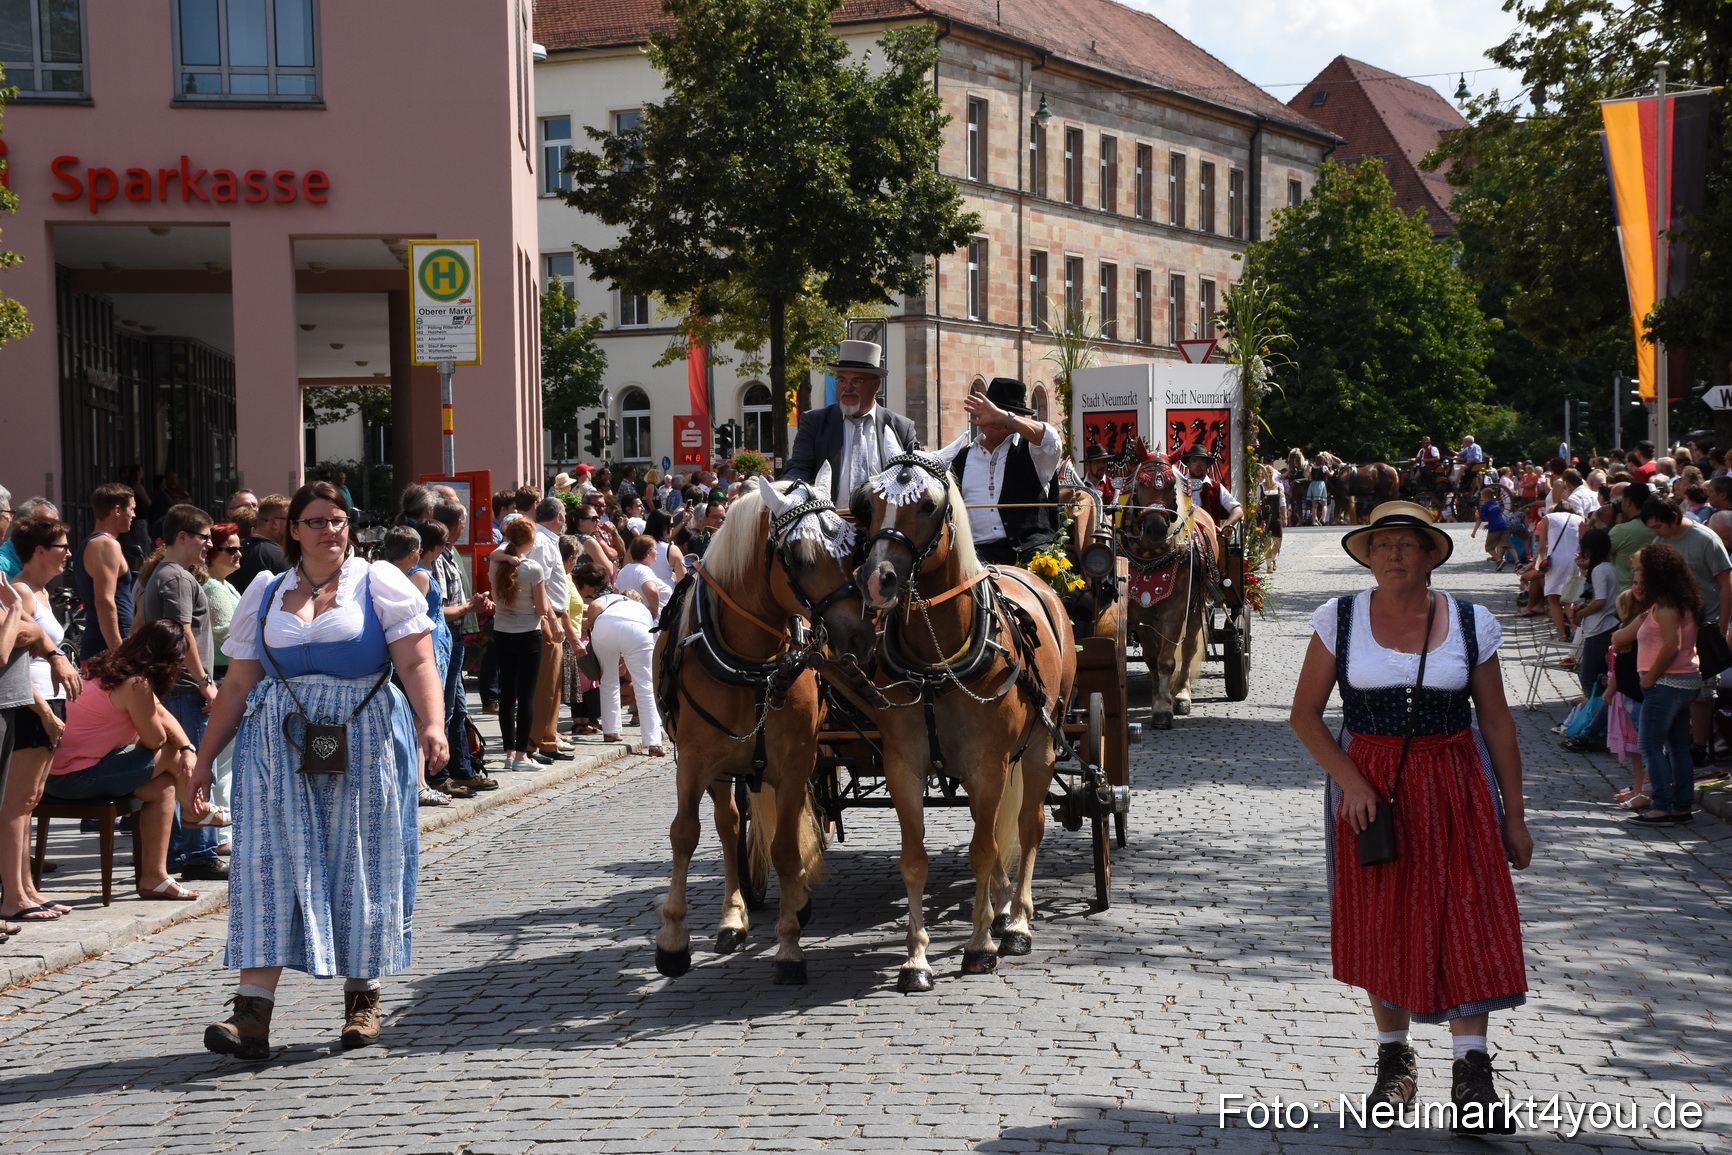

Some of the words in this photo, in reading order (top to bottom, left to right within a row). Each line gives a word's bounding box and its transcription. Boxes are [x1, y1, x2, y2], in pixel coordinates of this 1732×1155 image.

[51, 155, 330, 213] Sparkasse
[432, 262, 456, 290] H
[1082, 394, 1101, 408] Stadt
[1102, 391, 1138, 407] Neumarkt
[1166, 390, 1189, 404] Stadt
[1190, 390, 1232, 404] Neumarkt
